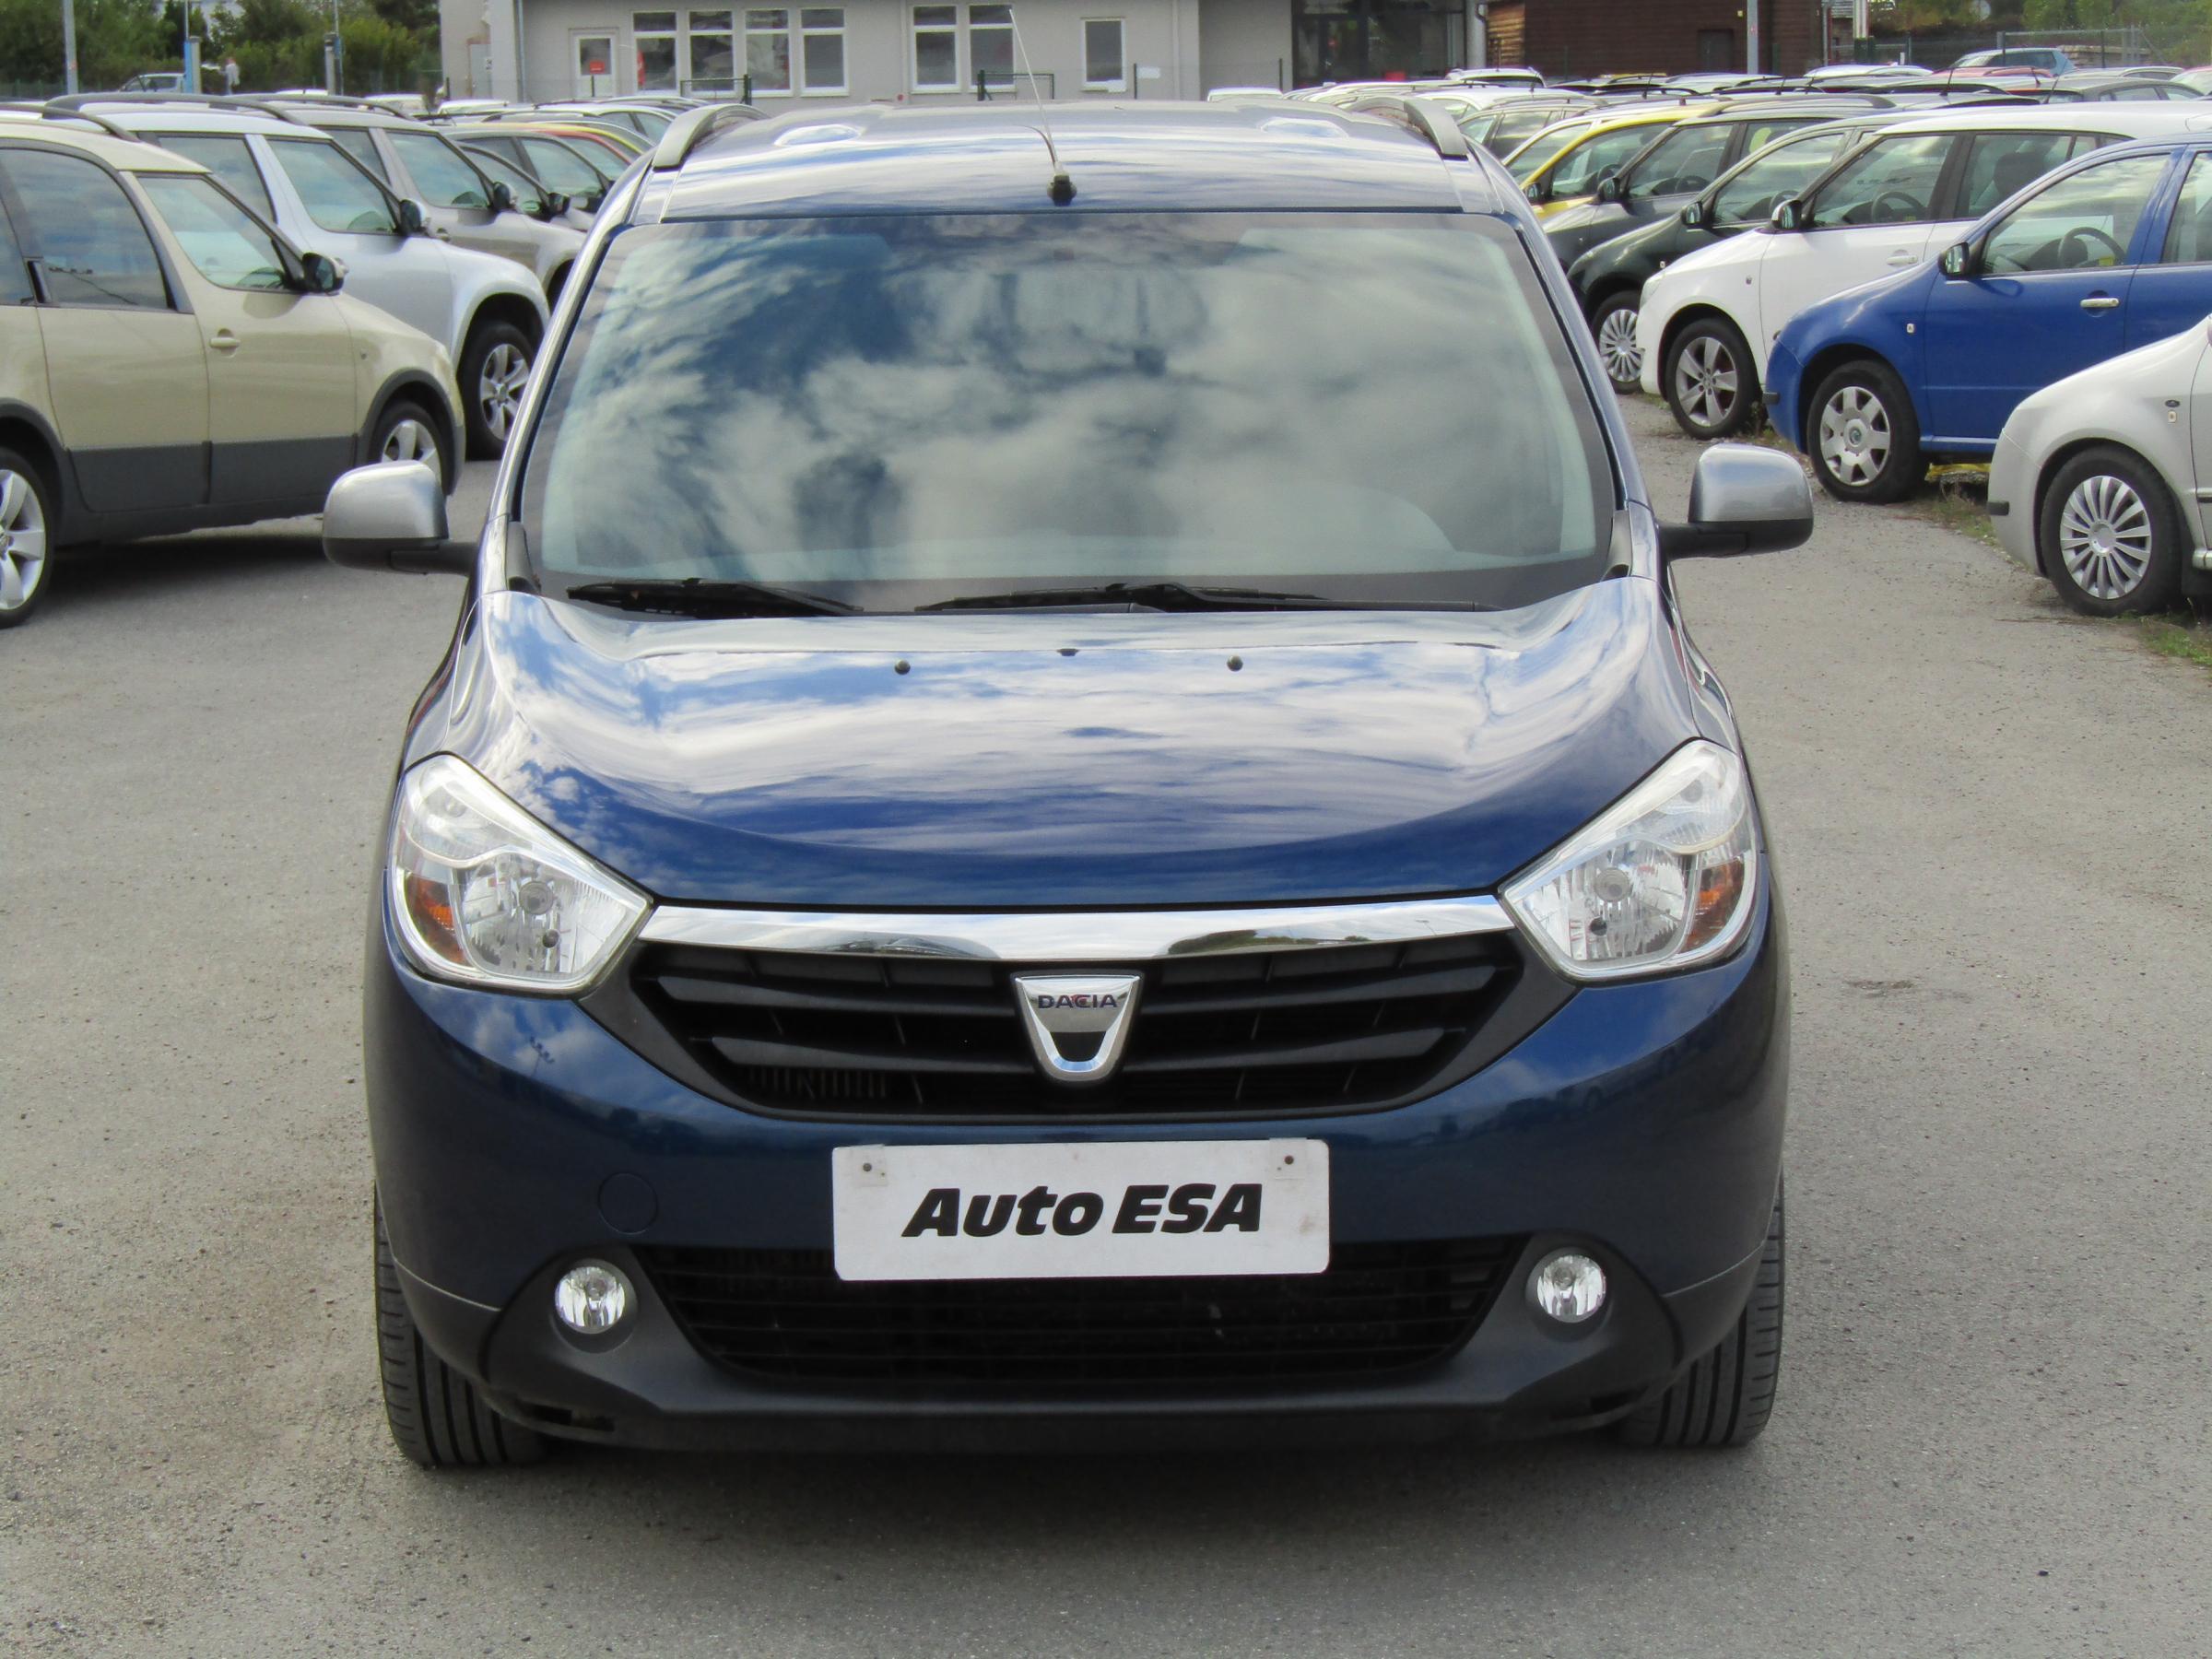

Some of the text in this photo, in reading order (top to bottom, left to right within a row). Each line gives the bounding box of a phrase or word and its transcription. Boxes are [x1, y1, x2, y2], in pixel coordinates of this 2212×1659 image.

[1038, 994, 1118, 1009] DACIA
[900, 1182, 1263, 1238] Auto ESA
